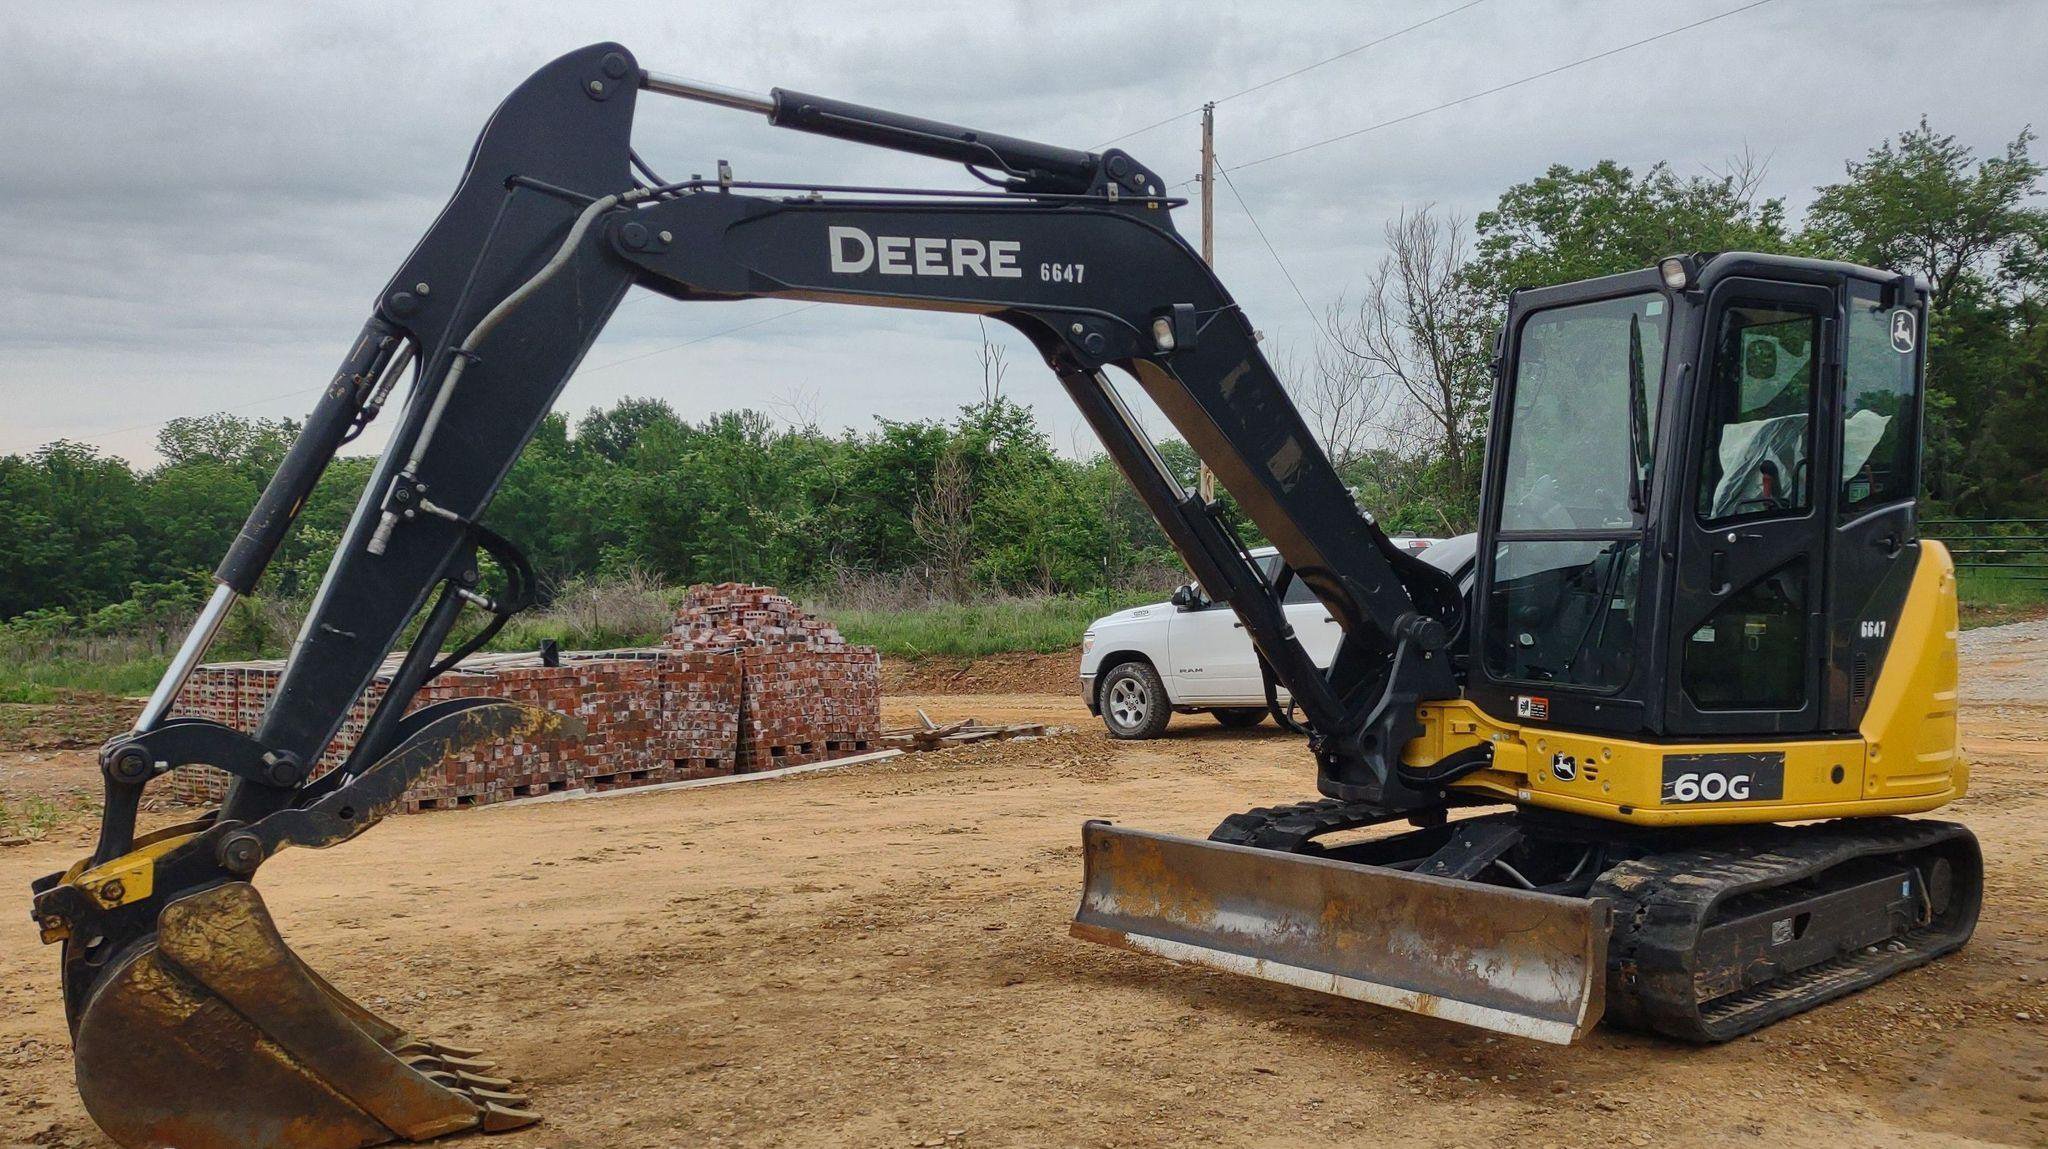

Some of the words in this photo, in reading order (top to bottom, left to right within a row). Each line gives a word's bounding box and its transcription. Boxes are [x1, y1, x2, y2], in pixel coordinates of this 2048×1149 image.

[829, 226, 1022, 278] DEERE
[1040, 263, 1085, 283] 6647
[1861, 621, 1886, 638] 6647
[1674, 772, 1750, 802] 60G
